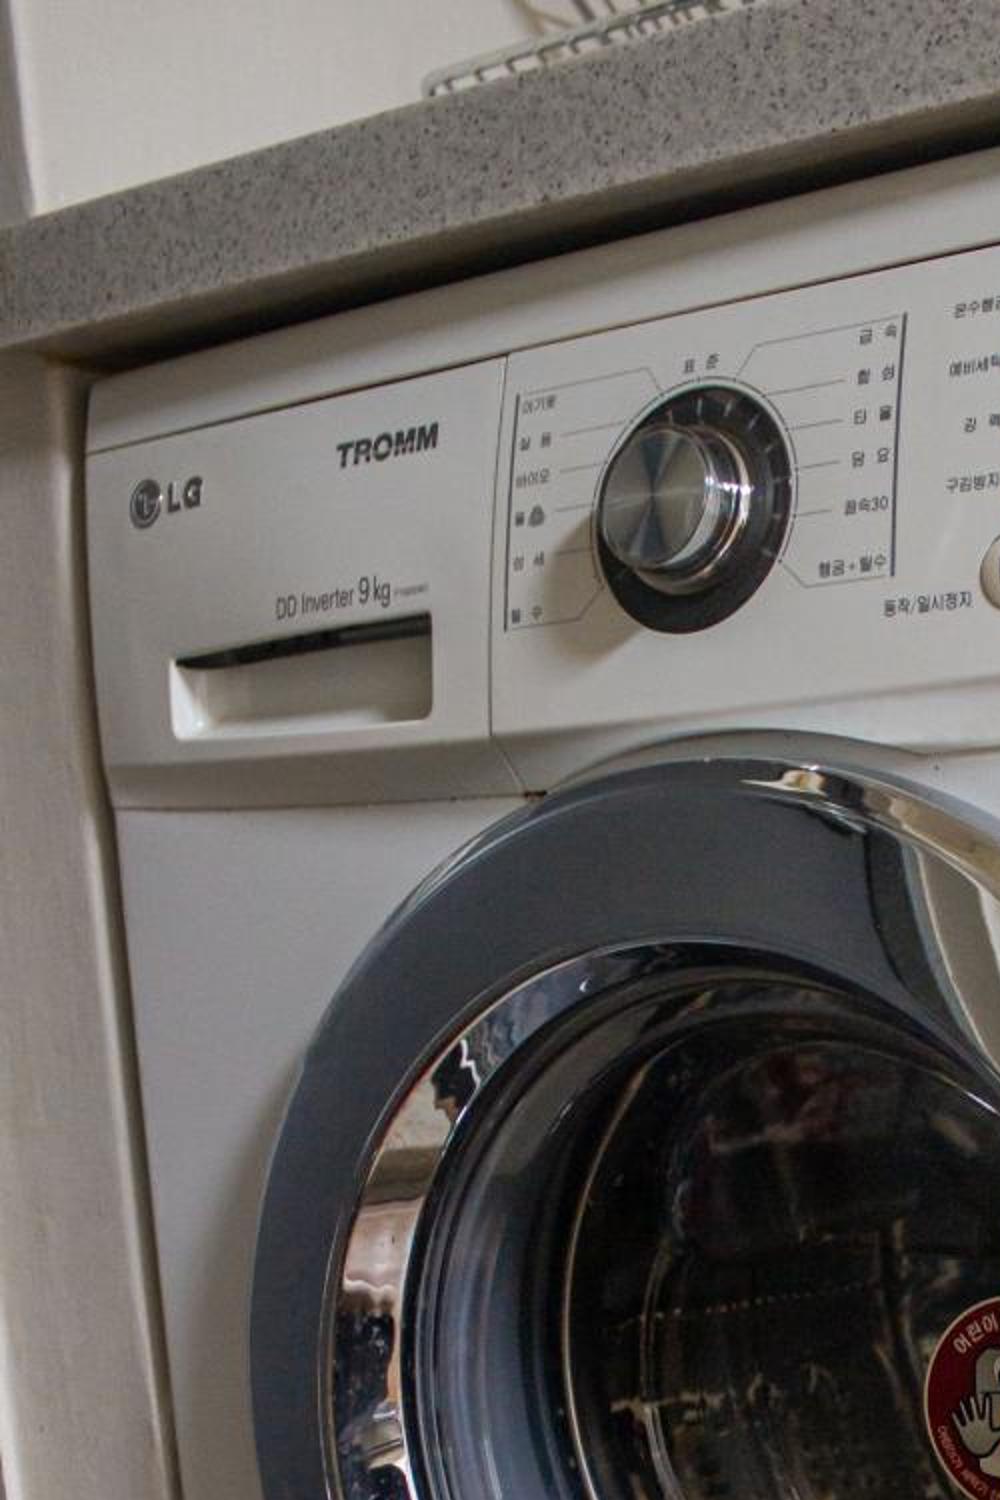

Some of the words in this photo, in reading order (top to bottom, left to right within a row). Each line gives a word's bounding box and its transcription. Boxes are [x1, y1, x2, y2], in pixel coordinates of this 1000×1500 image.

[336, 421, 439, 469] TROMM
[167, 476, 203, 513] LG
[944, 471, 999, 494] 구김방지
[275, 594, 297, 620] DD
[301, 587, 354, 615] Inverter
[953, 1311, 999, 1354] 어린이
